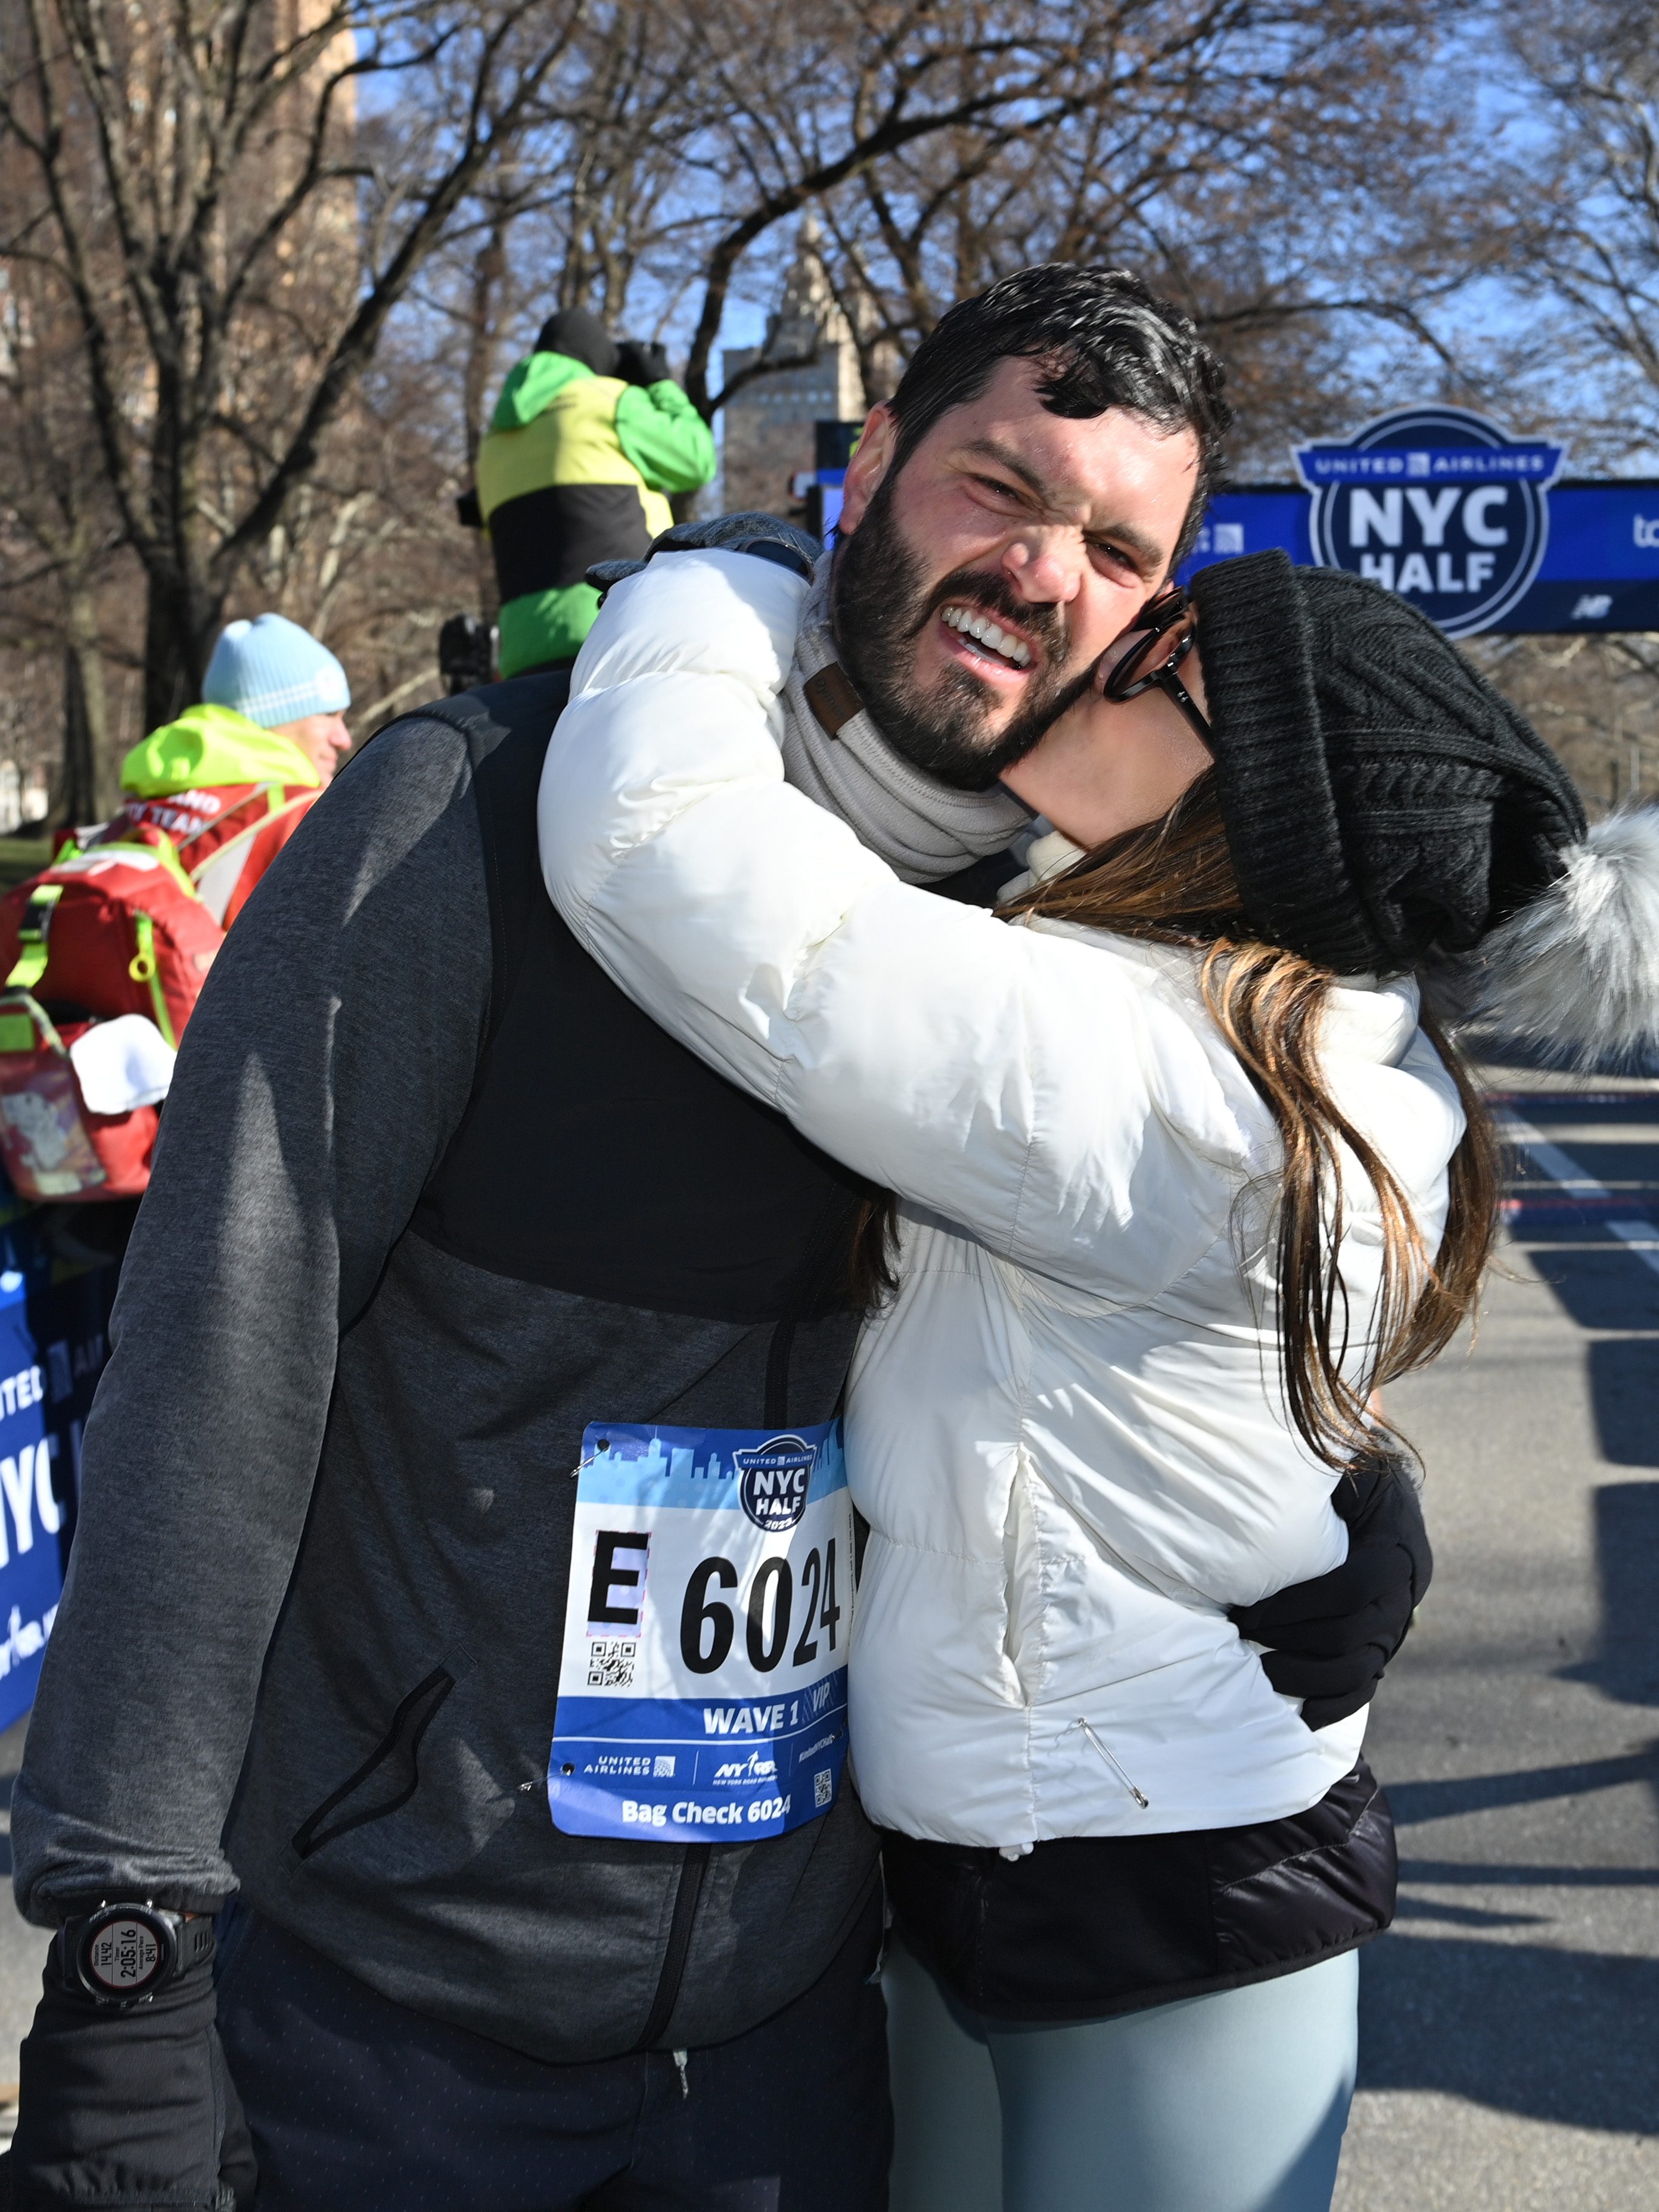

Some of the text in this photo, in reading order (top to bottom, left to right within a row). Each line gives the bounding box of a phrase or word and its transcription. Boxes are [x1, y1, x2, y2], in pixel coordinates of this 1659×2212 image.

[1315, 455, 1545, 475] UNITED AIRLINES
[1349, 486, 1508, 548] NYC
[1360, 553, 1496, 593] HALF
[786, 1454, 813, 1464] AIRLINES
[753, 1468, 805, 1496] NYC
[755, 1496, 801, 1515] HALF
[587, 1531, 649, 1625] E
[679, 1537, 841, 1675] 6024
[703, 1681, 831, 1735] WAVE 1 VIP
[583, 1764, 651, 1776] AIRLINES
[598, 1756, 651, 1766] UNITED
[622, 1794, 791, 1828] Bag Check 6024
[101, 1942, 112, 1966] 14.42
[120, 1929, 136, 1978] 2:05:16
[145, 1943, 156, 1962] 8:41
